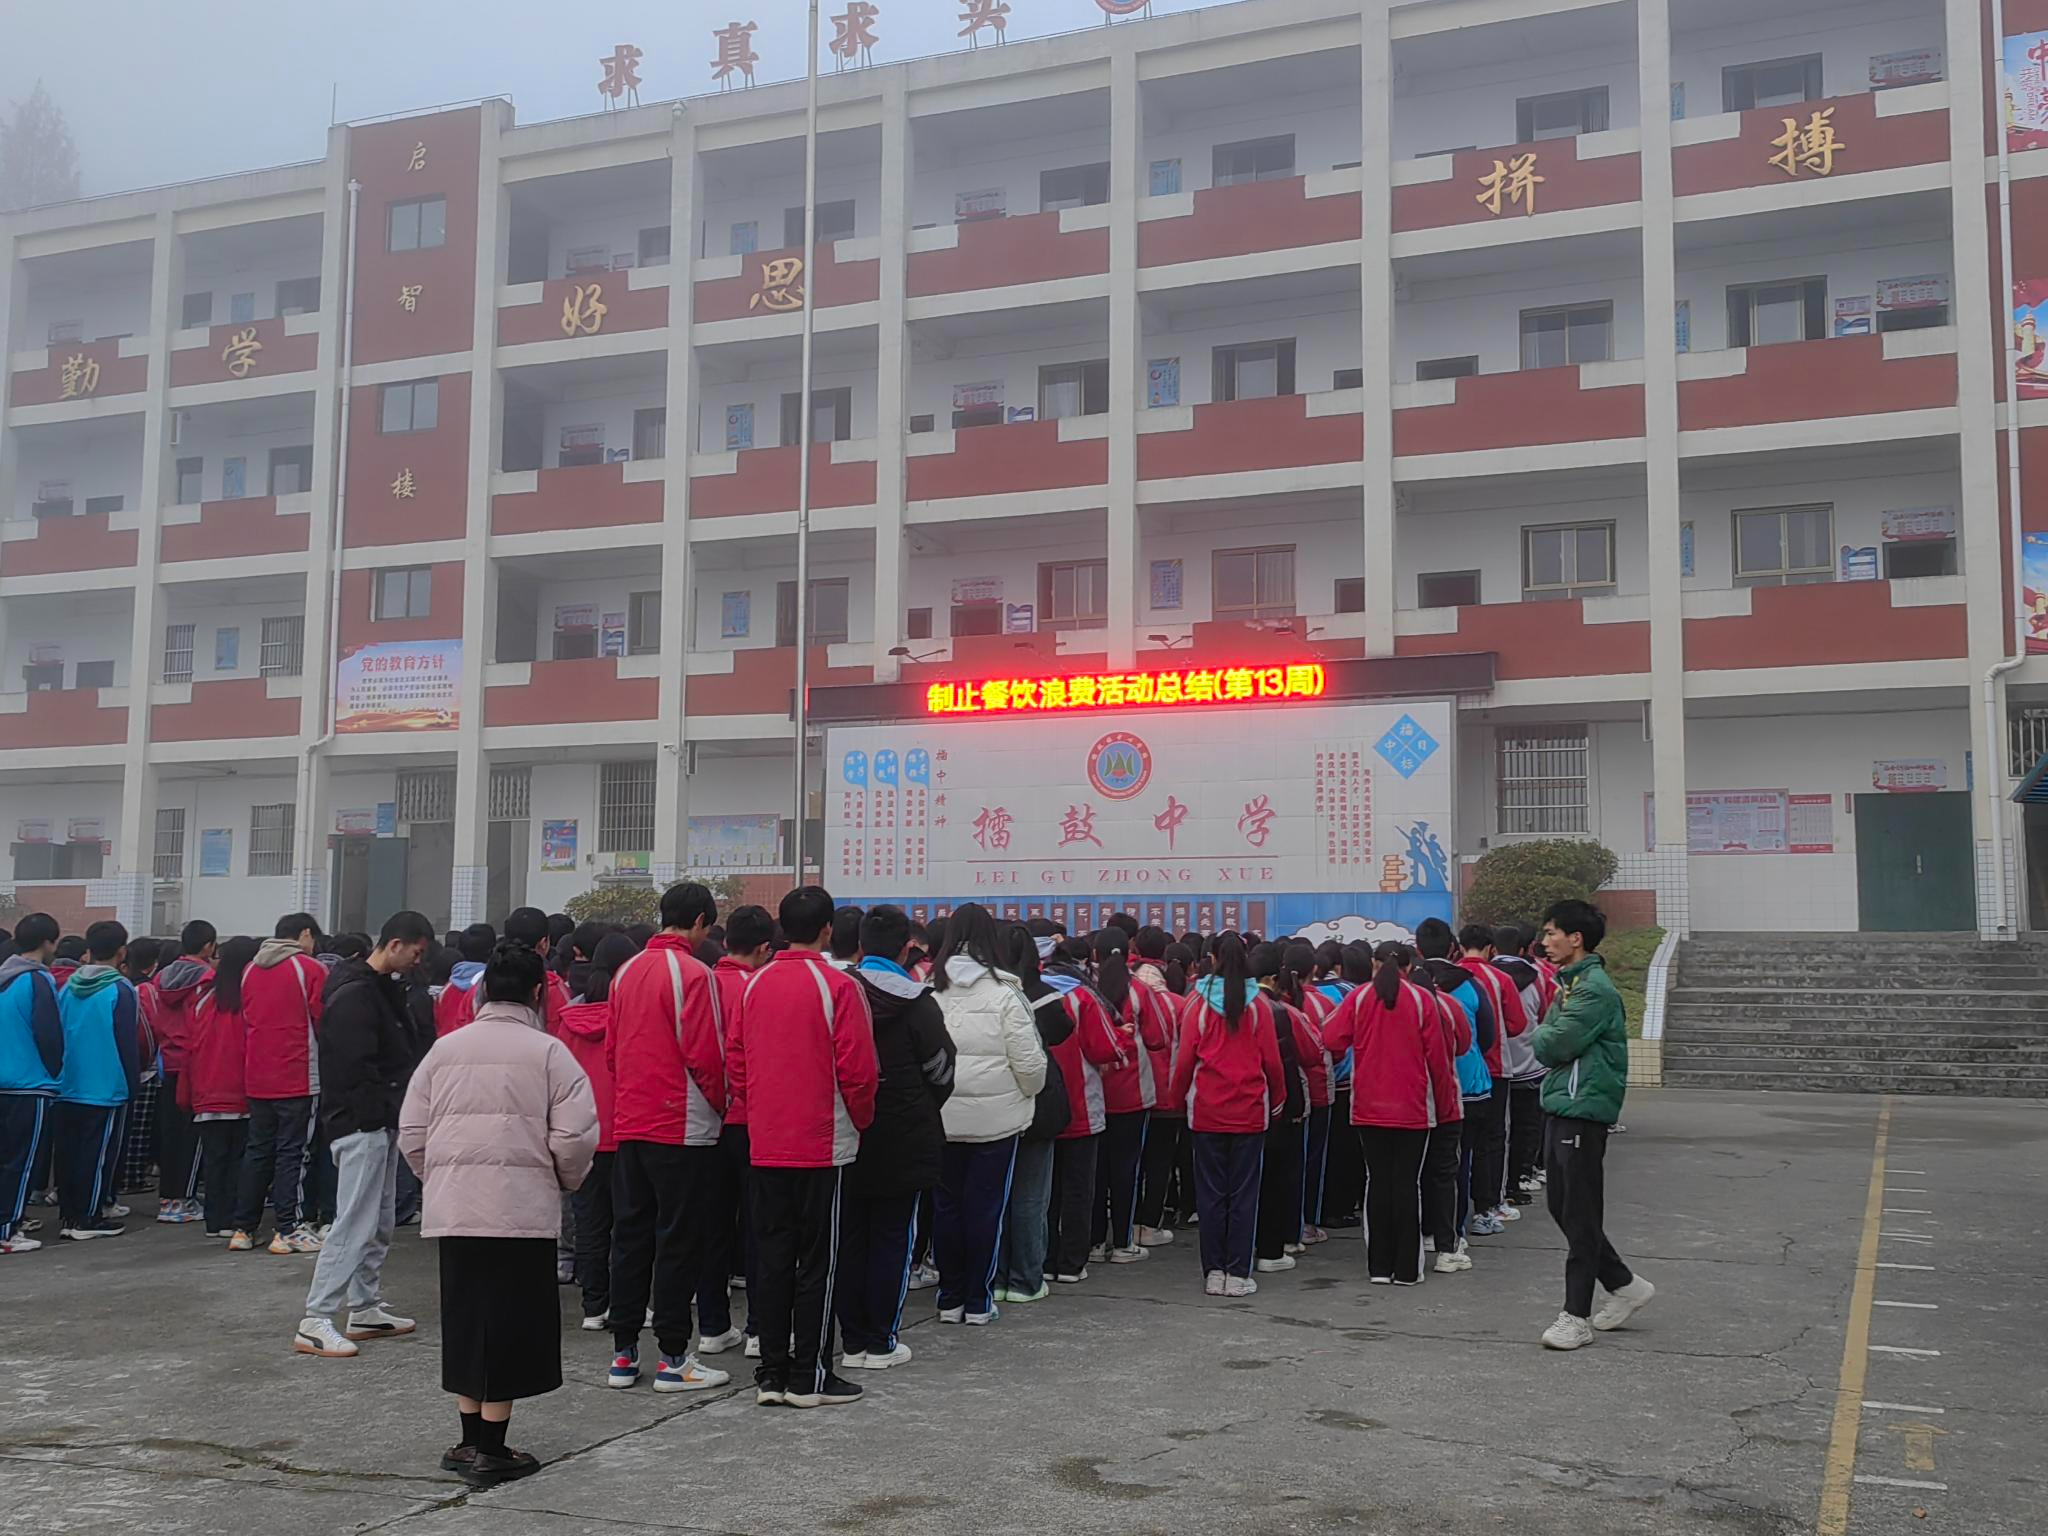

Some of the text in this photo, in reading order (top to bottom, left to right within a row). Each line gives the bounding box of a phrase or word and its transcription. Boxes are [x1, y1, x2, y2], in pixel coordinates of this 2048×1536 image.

[361, 654, 444, 673] 党的教育方针
[926, 664, 1325, 713] 制止餐饮浪费活动总结(第13周)
[971, 793, 1277, 851] 擂鼓中学
[975, 867, 1274, 884] LEI GU ZHONG XUE
